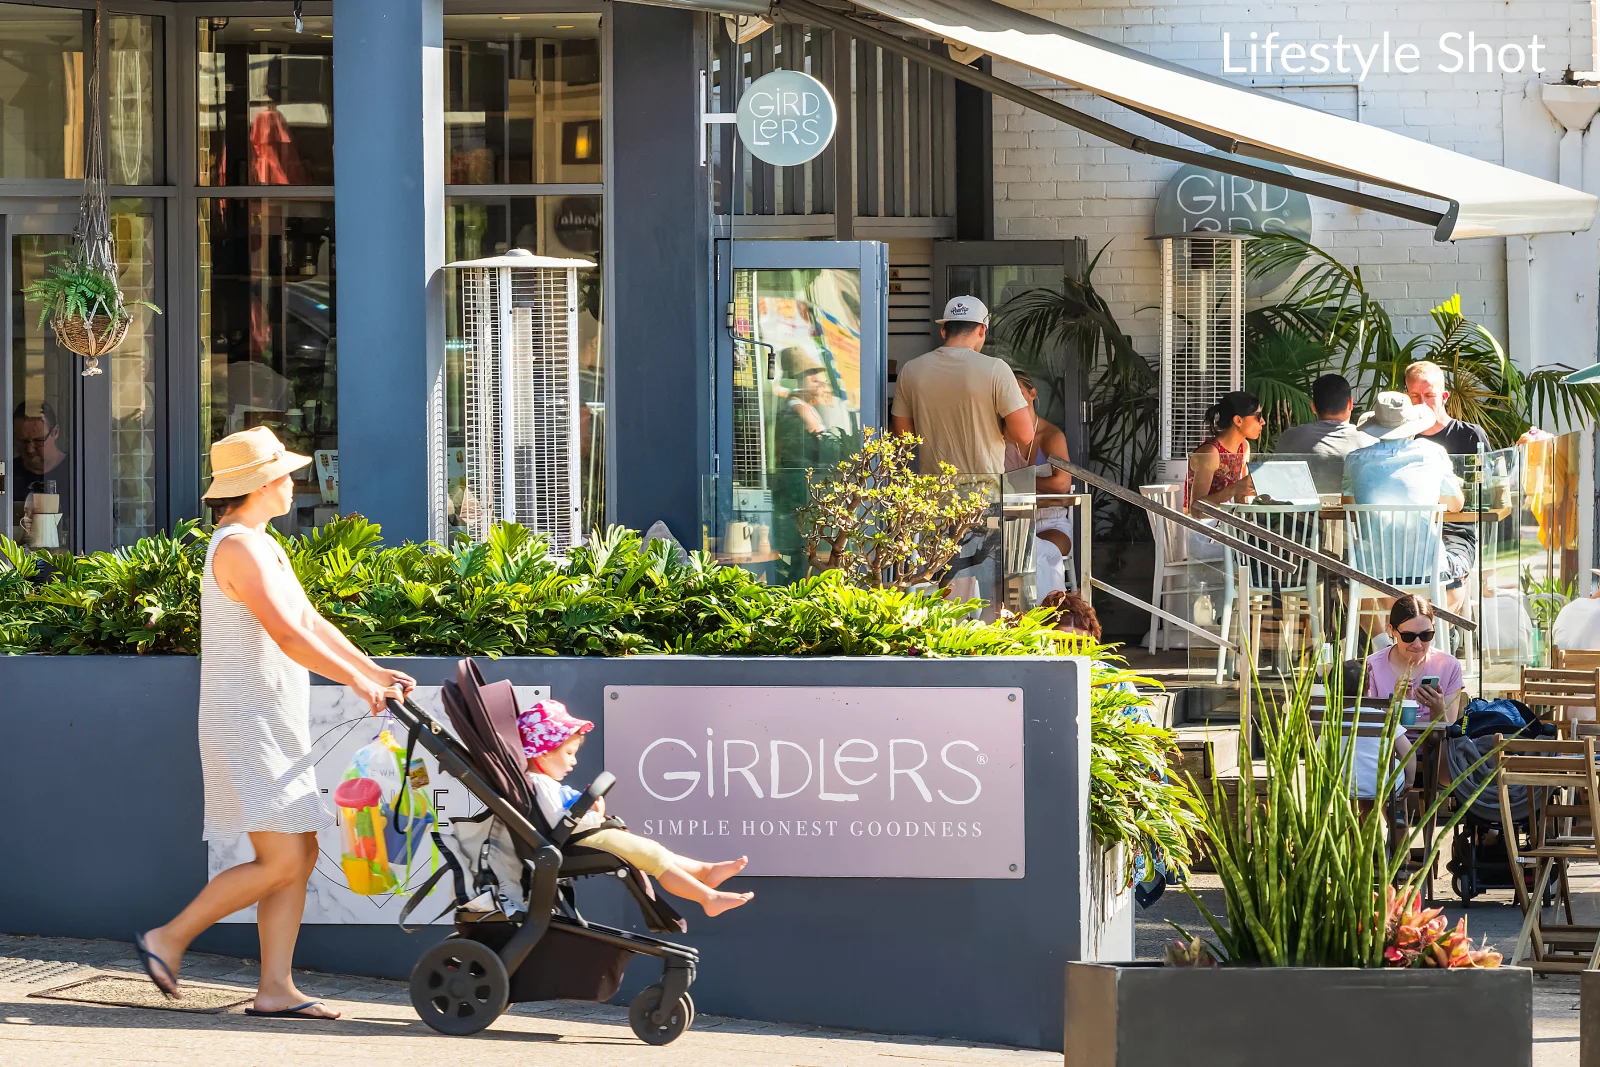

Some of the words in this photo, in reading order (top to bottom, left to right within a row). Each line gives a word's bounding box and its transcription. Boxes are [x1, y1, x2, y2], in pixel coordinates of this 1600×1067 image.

[643, 819, 730, 836] SIMPLE
[742, 820, 838, 837] HONEST
[850, 820, 982, 838] GOODNESS
